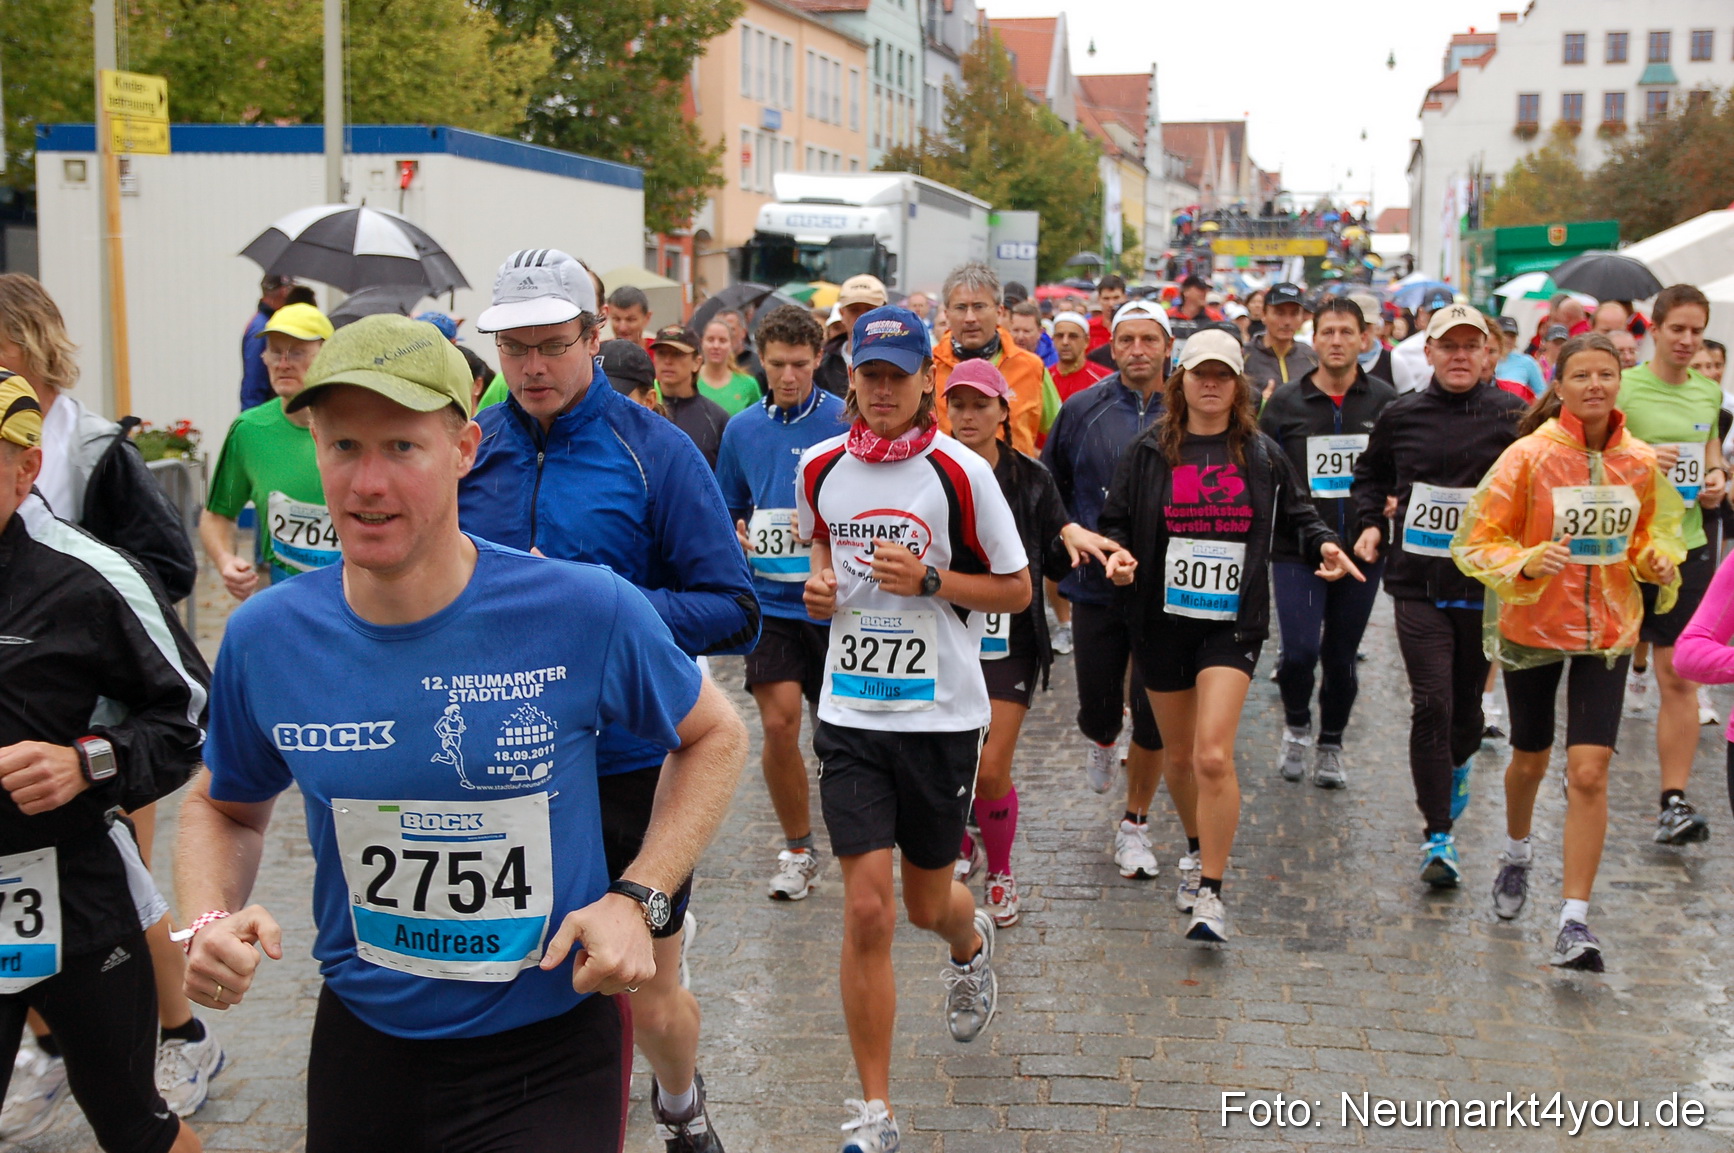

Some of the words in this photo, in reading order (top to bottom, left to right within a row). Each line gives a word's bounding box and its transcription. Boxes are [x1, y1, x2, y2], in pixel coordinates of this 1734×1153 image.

[383, 338, 433, 361] Columbia
[1674, 460, 1699, 483] 59
[1166, 519, 1212, 534] Kerstin
[1412, 503, 1465, 532] 290
[1563, 507, 1632, 536] 3269
[274, 513, 340, 548] 2764
[754, 528, 812, 555] 337
[829, 522, 909, 540] GERHART
[910, 529, 919, 539] &
[1173, 559, 1240, 592] 3018
[1180, 593, 1229, 610] Michaela
[860, 616, 902, 627] BOCK
[840, 634, 926, 674] 3272
[421, 676, 449, 691] 12.
[451, 665, 567, 689] NEUMARKTER
[859, 680, 901, 698] Julius
[448, 683, 544, 703] STADTLAUF
[272, 720, 397, 752] BOCK
[494, 743, 555, 762] 18.09.2011
[400, 811, 484, 831] BOCK
[361, 845, 533, 915] 2754
[394, 923, 501, 955] Andreas
